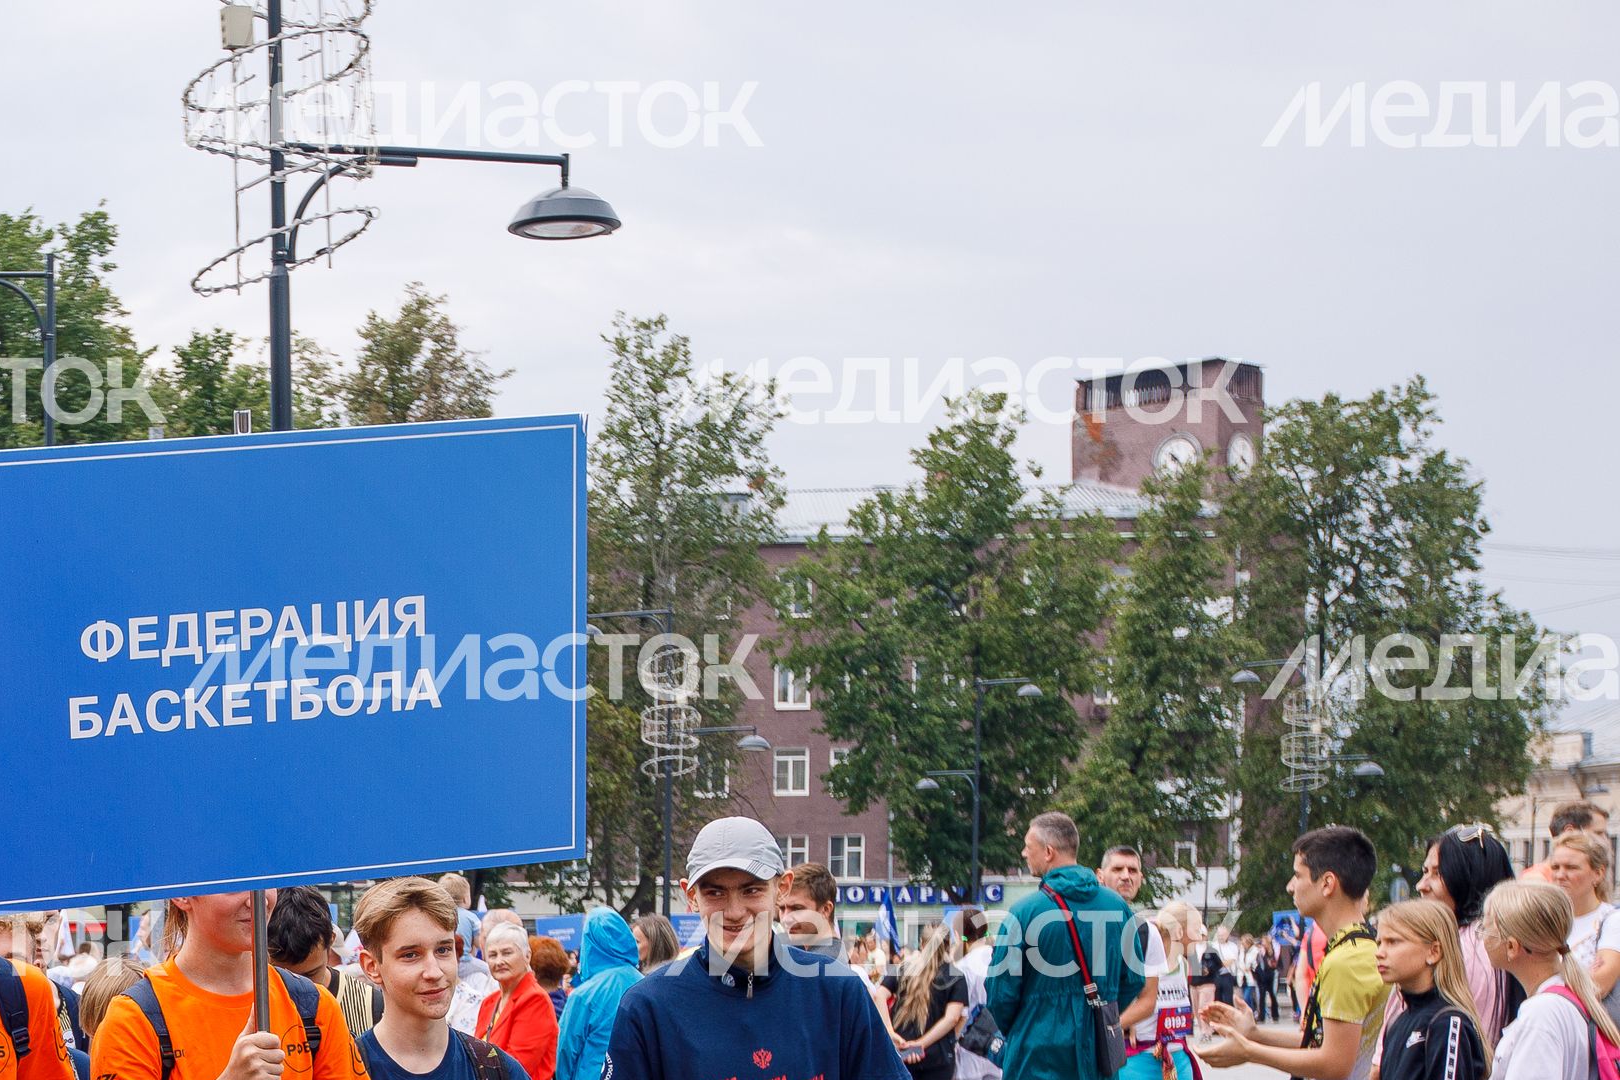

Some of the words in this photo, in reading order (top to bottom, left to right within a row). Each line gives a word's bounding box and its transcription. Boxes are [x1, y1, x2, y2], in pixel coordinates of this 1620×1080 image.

[80, 594, 426, 667] ФЕДЕРАЦИЯ
[68, 668, 443, 739] БАСКЕТБОЛА
[836, 886, 1000, 902] ОТАРС
